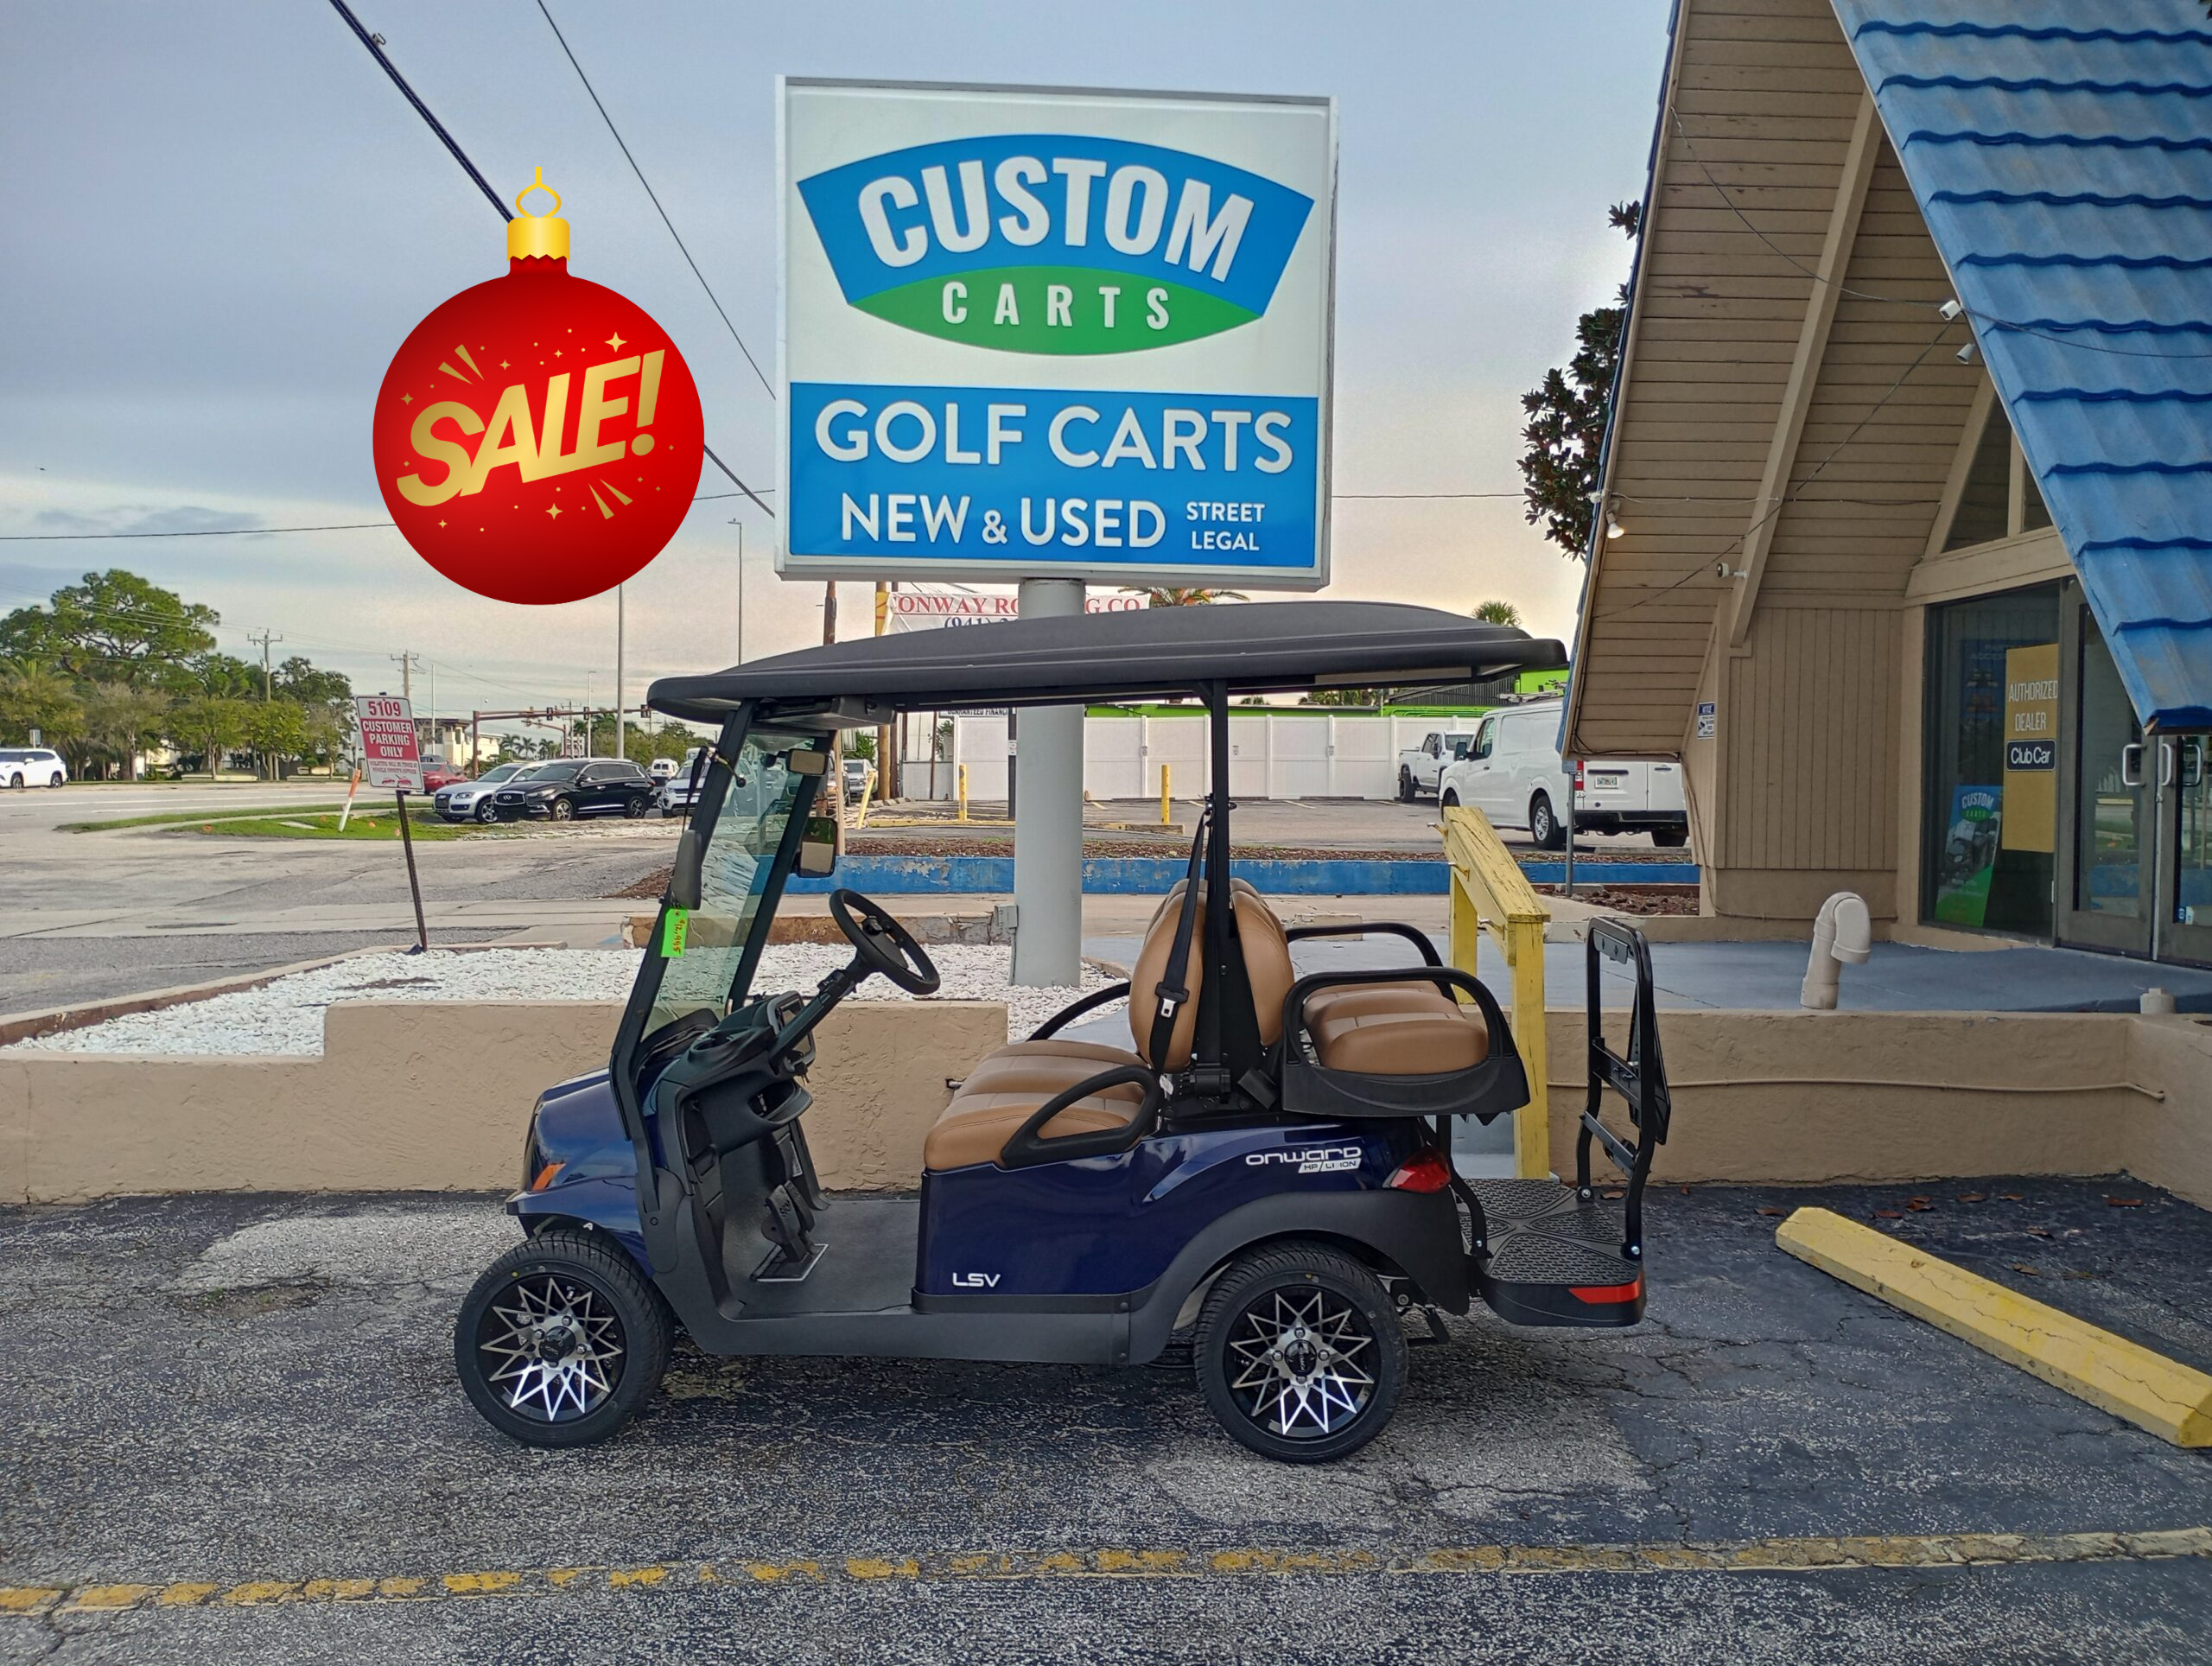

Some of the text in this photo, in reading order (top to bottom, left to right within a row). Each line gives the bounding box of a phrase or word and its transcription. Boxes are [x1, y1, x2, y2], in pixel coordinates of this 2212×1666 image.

[858, 156, 1255, 283] CUSTOM
[943, 282, 1170, 330] CARTS
[815, 398, 1294, 474] GOLF CARTS
[842, 493, 1167, 548] NEW & USED
[1186, 501, 1266, 523] STREET
[1192, 531, 1260, 551] LEGAL
[893, 595, 987, 614] ONWAY
[2009, 680, 2058, 703] AUTHORIZED
[368, 701, 401, 716] 5109
[363, 721, 413, 734] CUSTOMER
[2015, 712, 2046, 731] DEALER
[369, 734, 410, 746] PARKING
[381, 746, 404, 758] ONLY
[2011, 747, 2051, 764] Club Car
[1961, 792, 1994, 810] CUSTOM
[952, 1272, 1001, 1288] LSV
